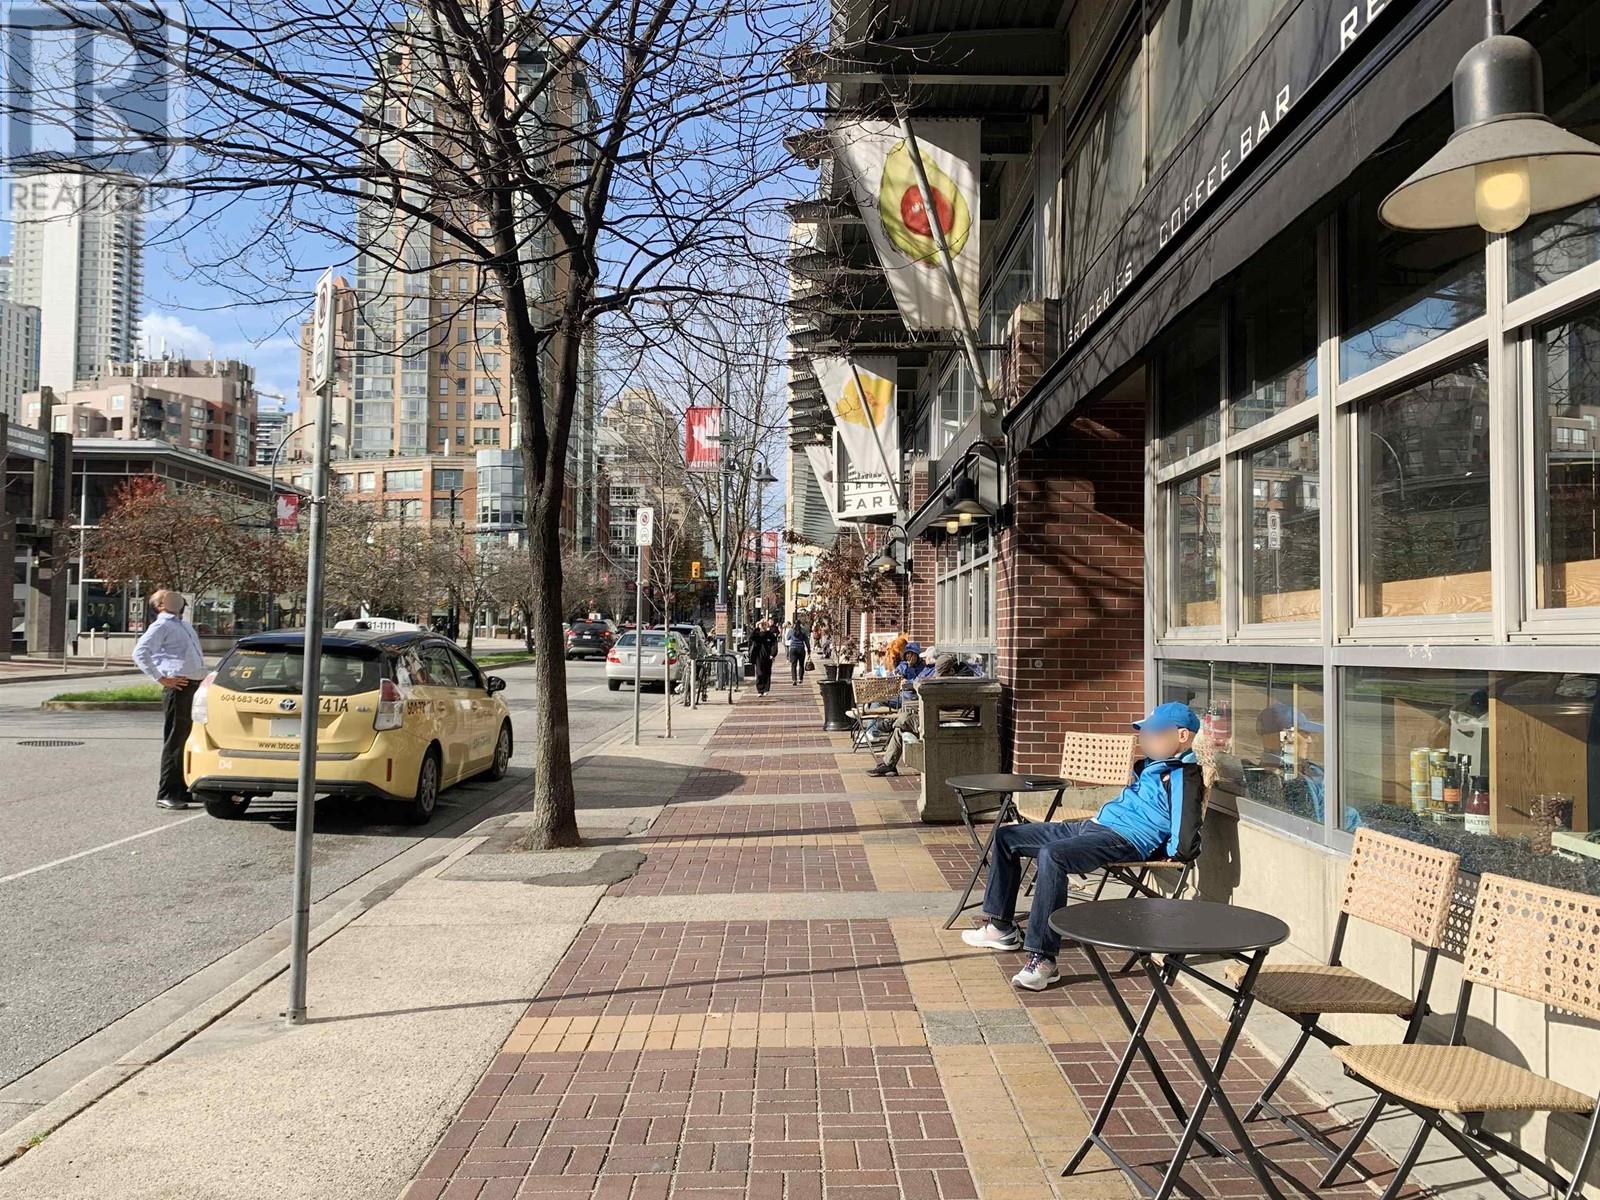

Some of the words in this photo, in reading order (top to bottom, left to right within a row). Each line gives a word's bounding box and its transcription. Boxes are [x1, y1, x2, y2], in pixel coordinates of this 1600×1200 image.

[1068, 261, 1132, 348] GROCERIES
[1160, 149, 1232, 248] COFFEE
[1240, 84, 1290, 160] BAR
